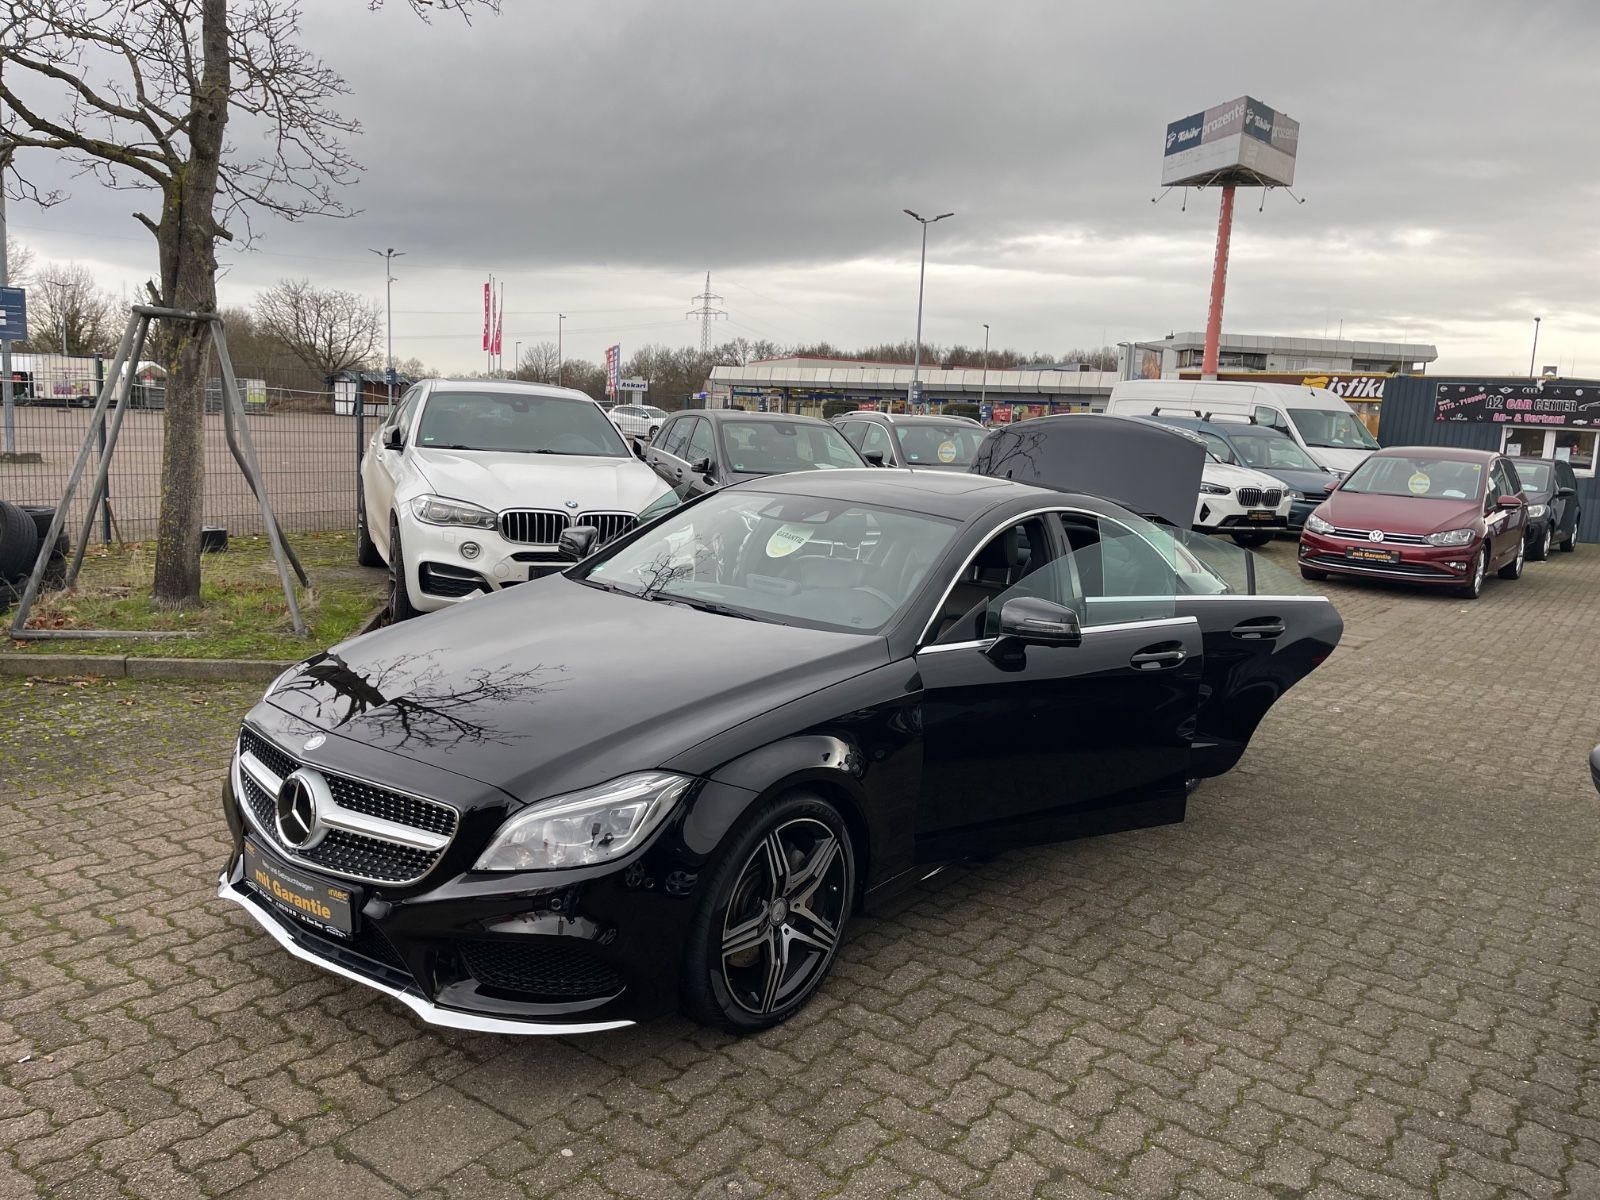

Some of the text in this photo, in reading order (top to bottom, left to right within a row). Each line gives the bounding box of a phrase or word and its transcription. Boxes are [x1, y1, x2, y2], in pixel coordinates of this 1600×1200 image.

[1203, 104, 1245, 136] prozente
[1485, 395, 1577, 412] A2 CAR CENTER
[1364, 552, 1392, 560] Garantie
[255, 869, 271, 890] mit
[273, 879, 331, 919] Garantie
